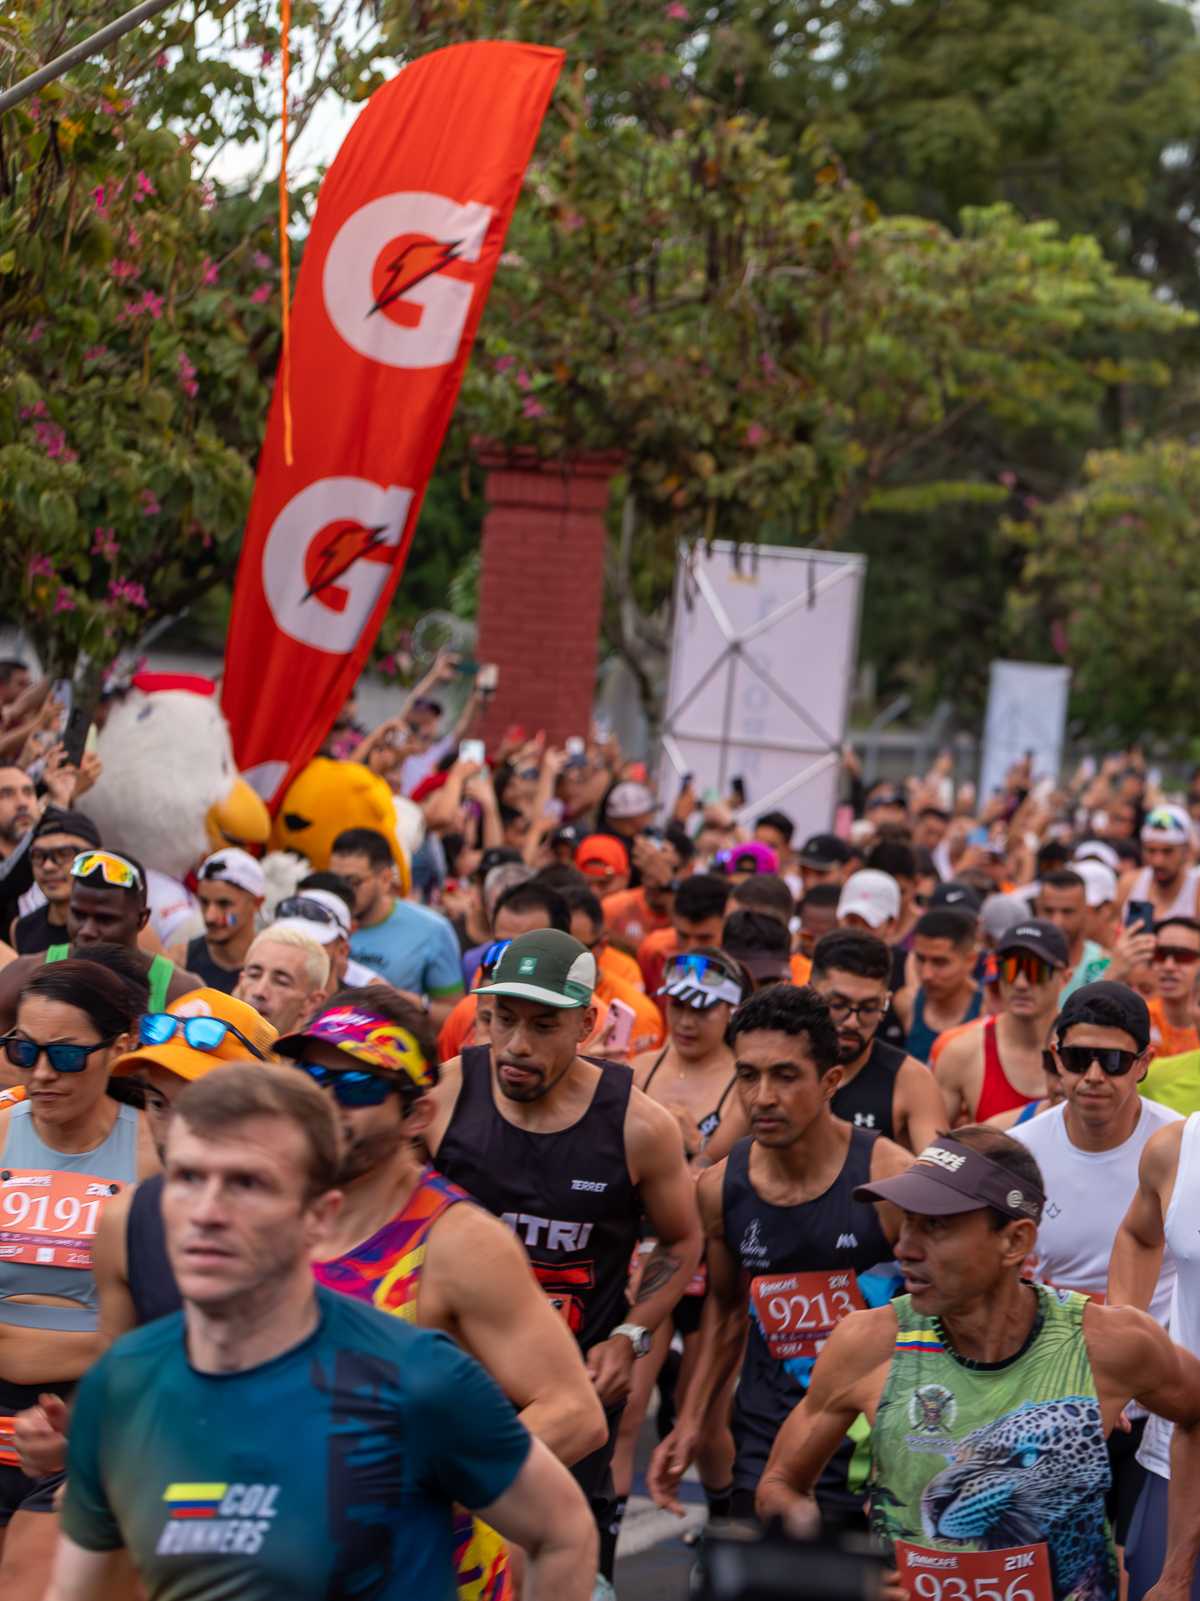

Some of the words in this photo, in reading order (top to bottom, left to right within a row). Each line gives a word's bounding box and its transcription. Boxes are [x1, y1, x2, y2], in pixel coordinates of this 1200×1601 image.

[323, 191, 496, 369] G
[262, 475, 415, 654] G
[571, 1179, 608, 1192] TERRET
[0, 1191, 100, 1235] 9191
[768, 1290, 857, 1331] 9213
[219, 1483, 281, 1517] COL
[1004, 1551, 1035, 1571] 21K
[914, 1573, 1035, 1601] 9356
